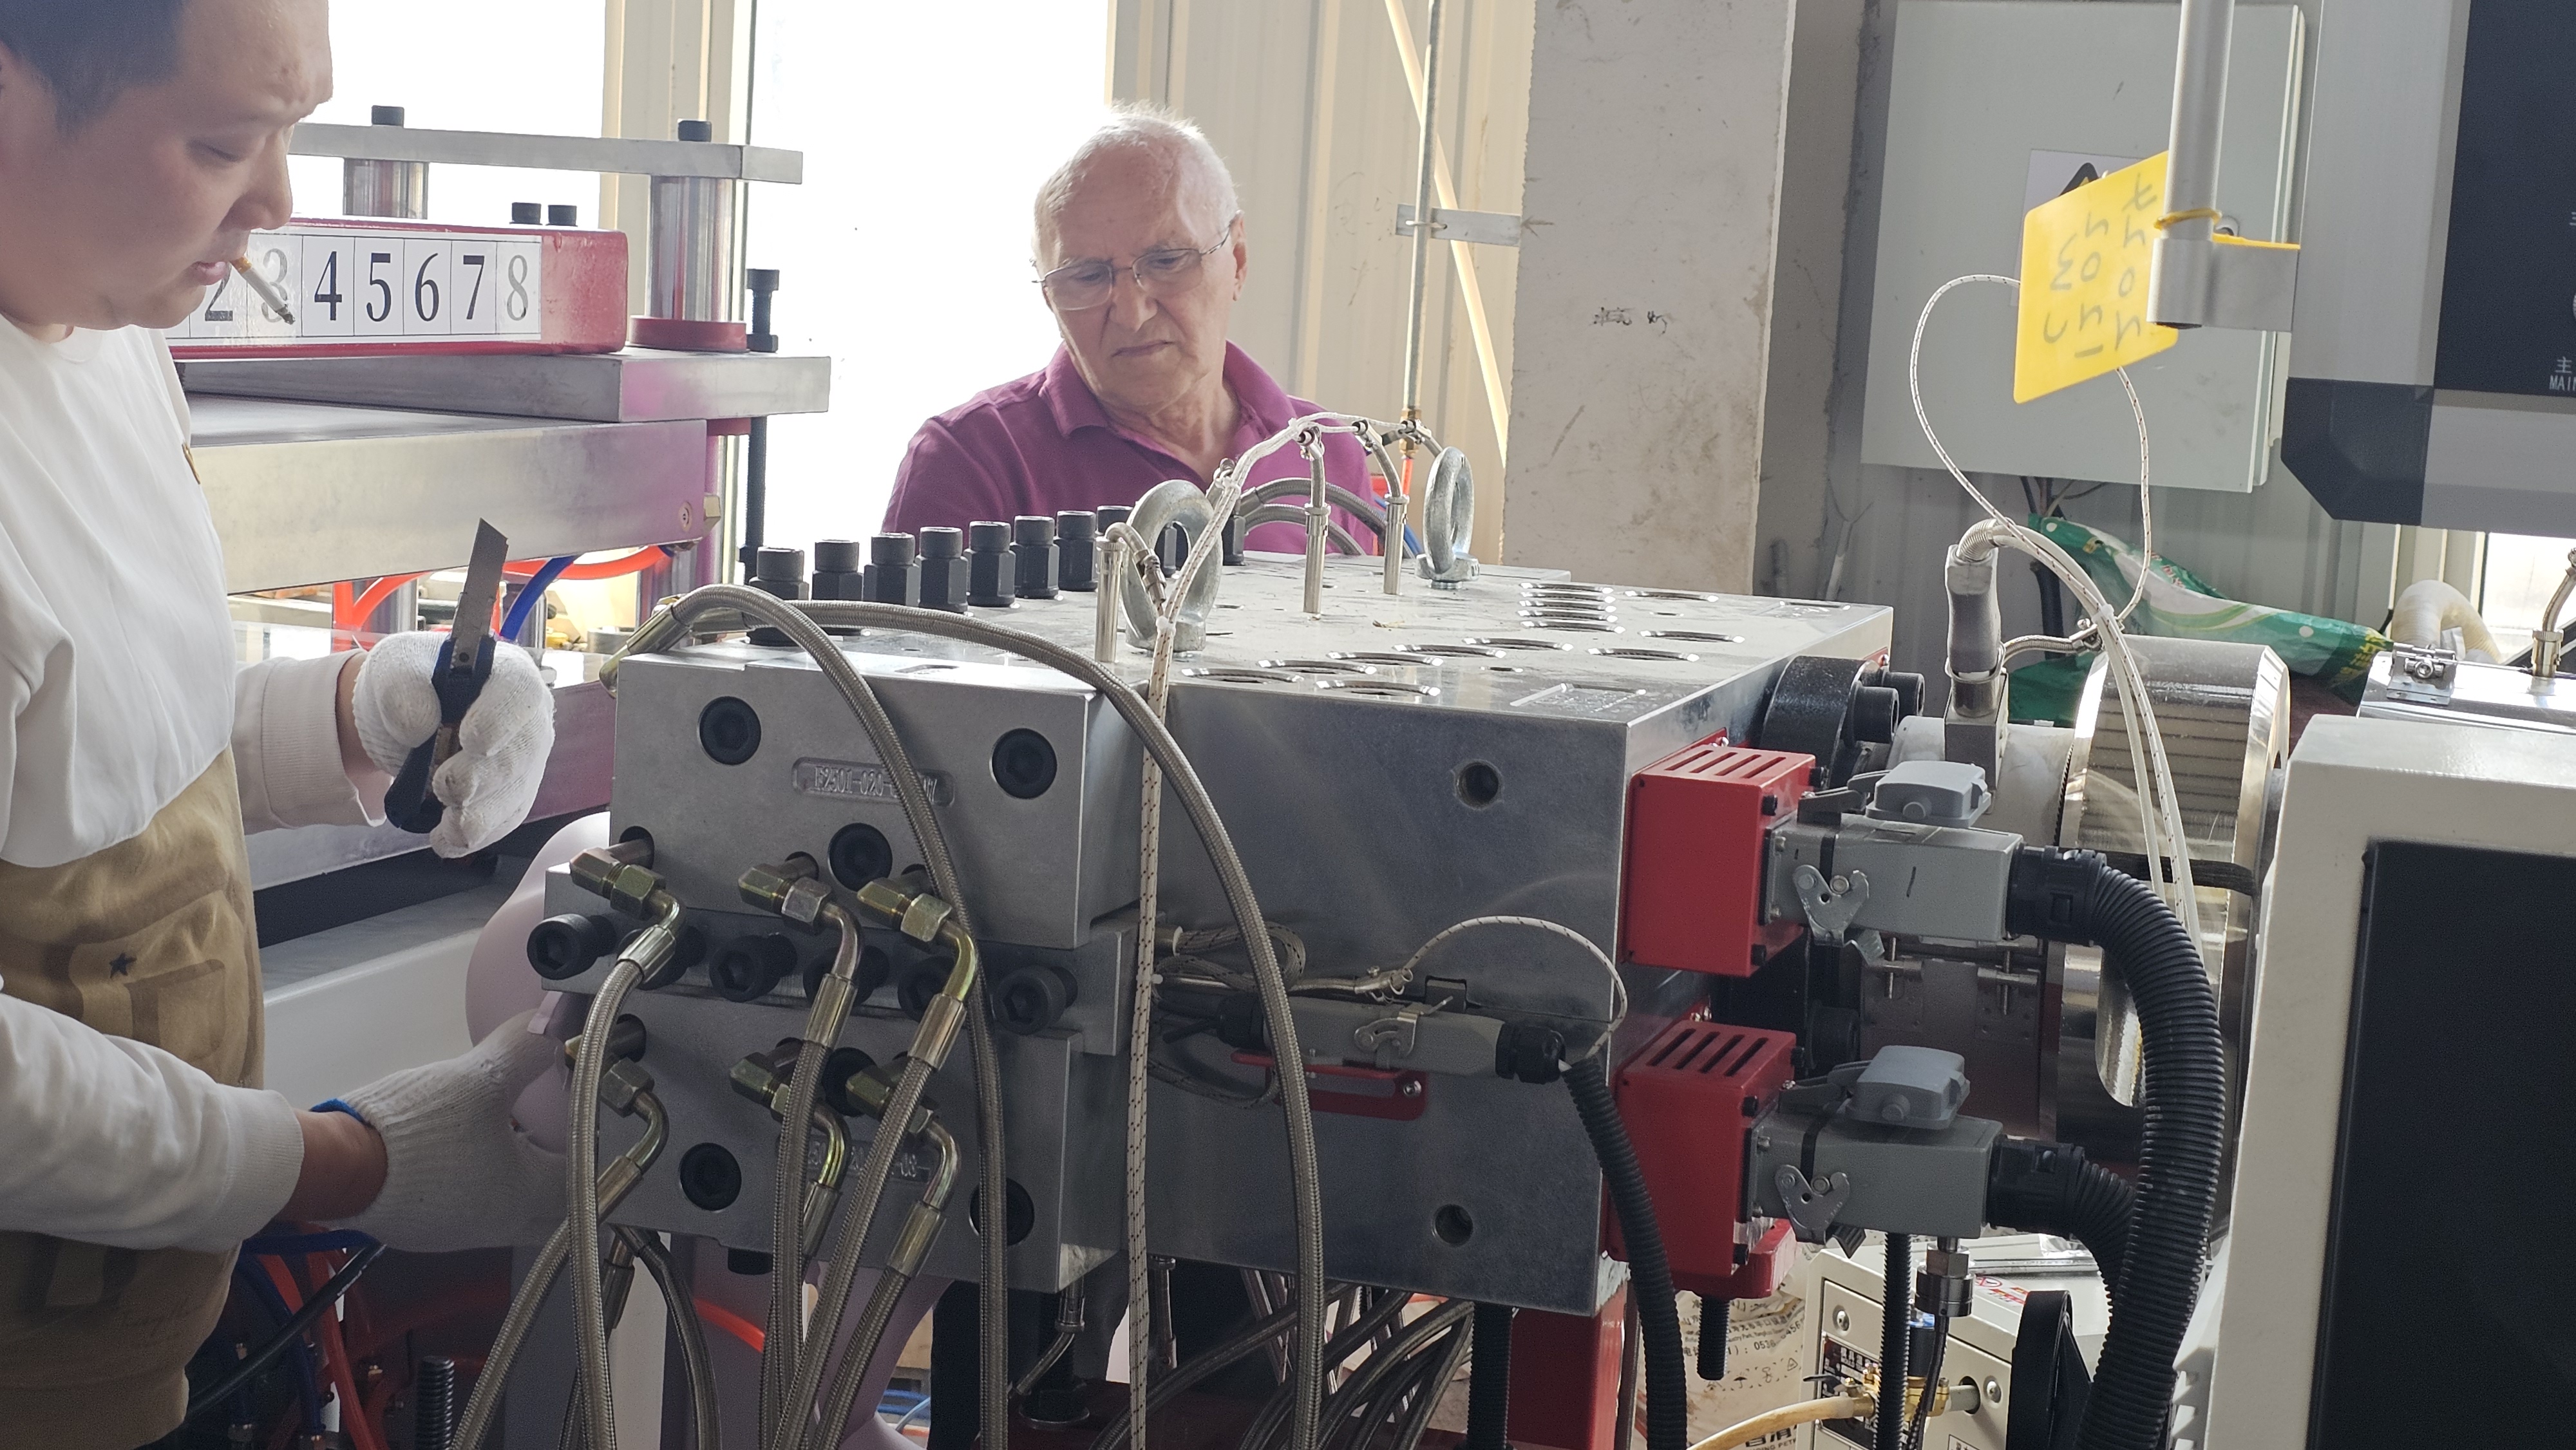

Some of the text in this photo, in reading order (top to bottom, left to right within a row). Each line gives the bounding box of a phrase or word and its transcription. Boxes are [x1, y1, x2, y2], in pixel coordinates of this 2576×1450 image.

[314, 251, 342, 321] 4
[366, 252, 392, 322] 5
[415, 252, 440, 322] 6
[463, 254, 485, 320] 7
[507, 254, 529, 321] 8
